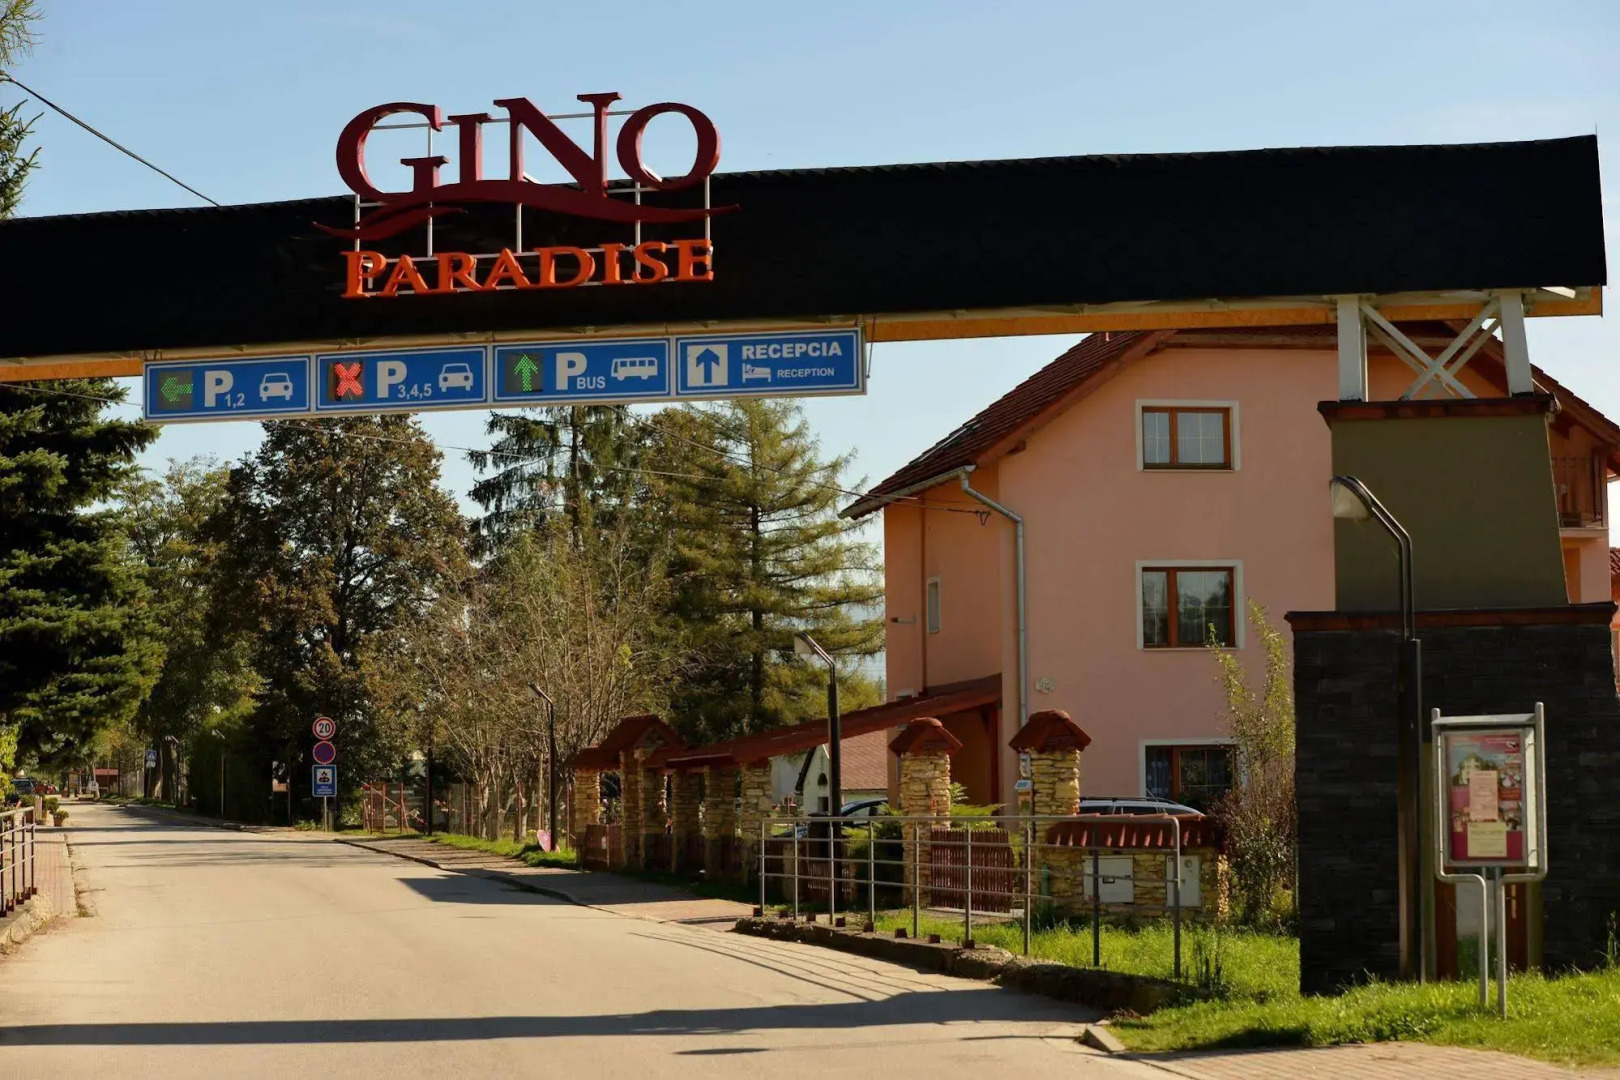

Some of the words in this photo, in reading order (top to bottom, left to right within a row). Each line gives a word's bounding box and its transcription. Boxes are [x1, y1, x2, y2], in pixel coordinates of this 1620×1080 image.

[336, 92, 720, 198] GINO
[341, 240, 714, 298] PARADISE
[741, 341, 843, 361] RECEPCIA
[204, 370, 234, 408] P
[225, 394, 245, 410] 1,2
[377, 360, 408, 398] P
[398, 384, 432, 400] 3,4,5
[556, 352, 587, 390] P
[576, 375, 607, 390] BUS
[777, 367, 835, 379] RECEPTION
[319, 723, 330, 733] 20
